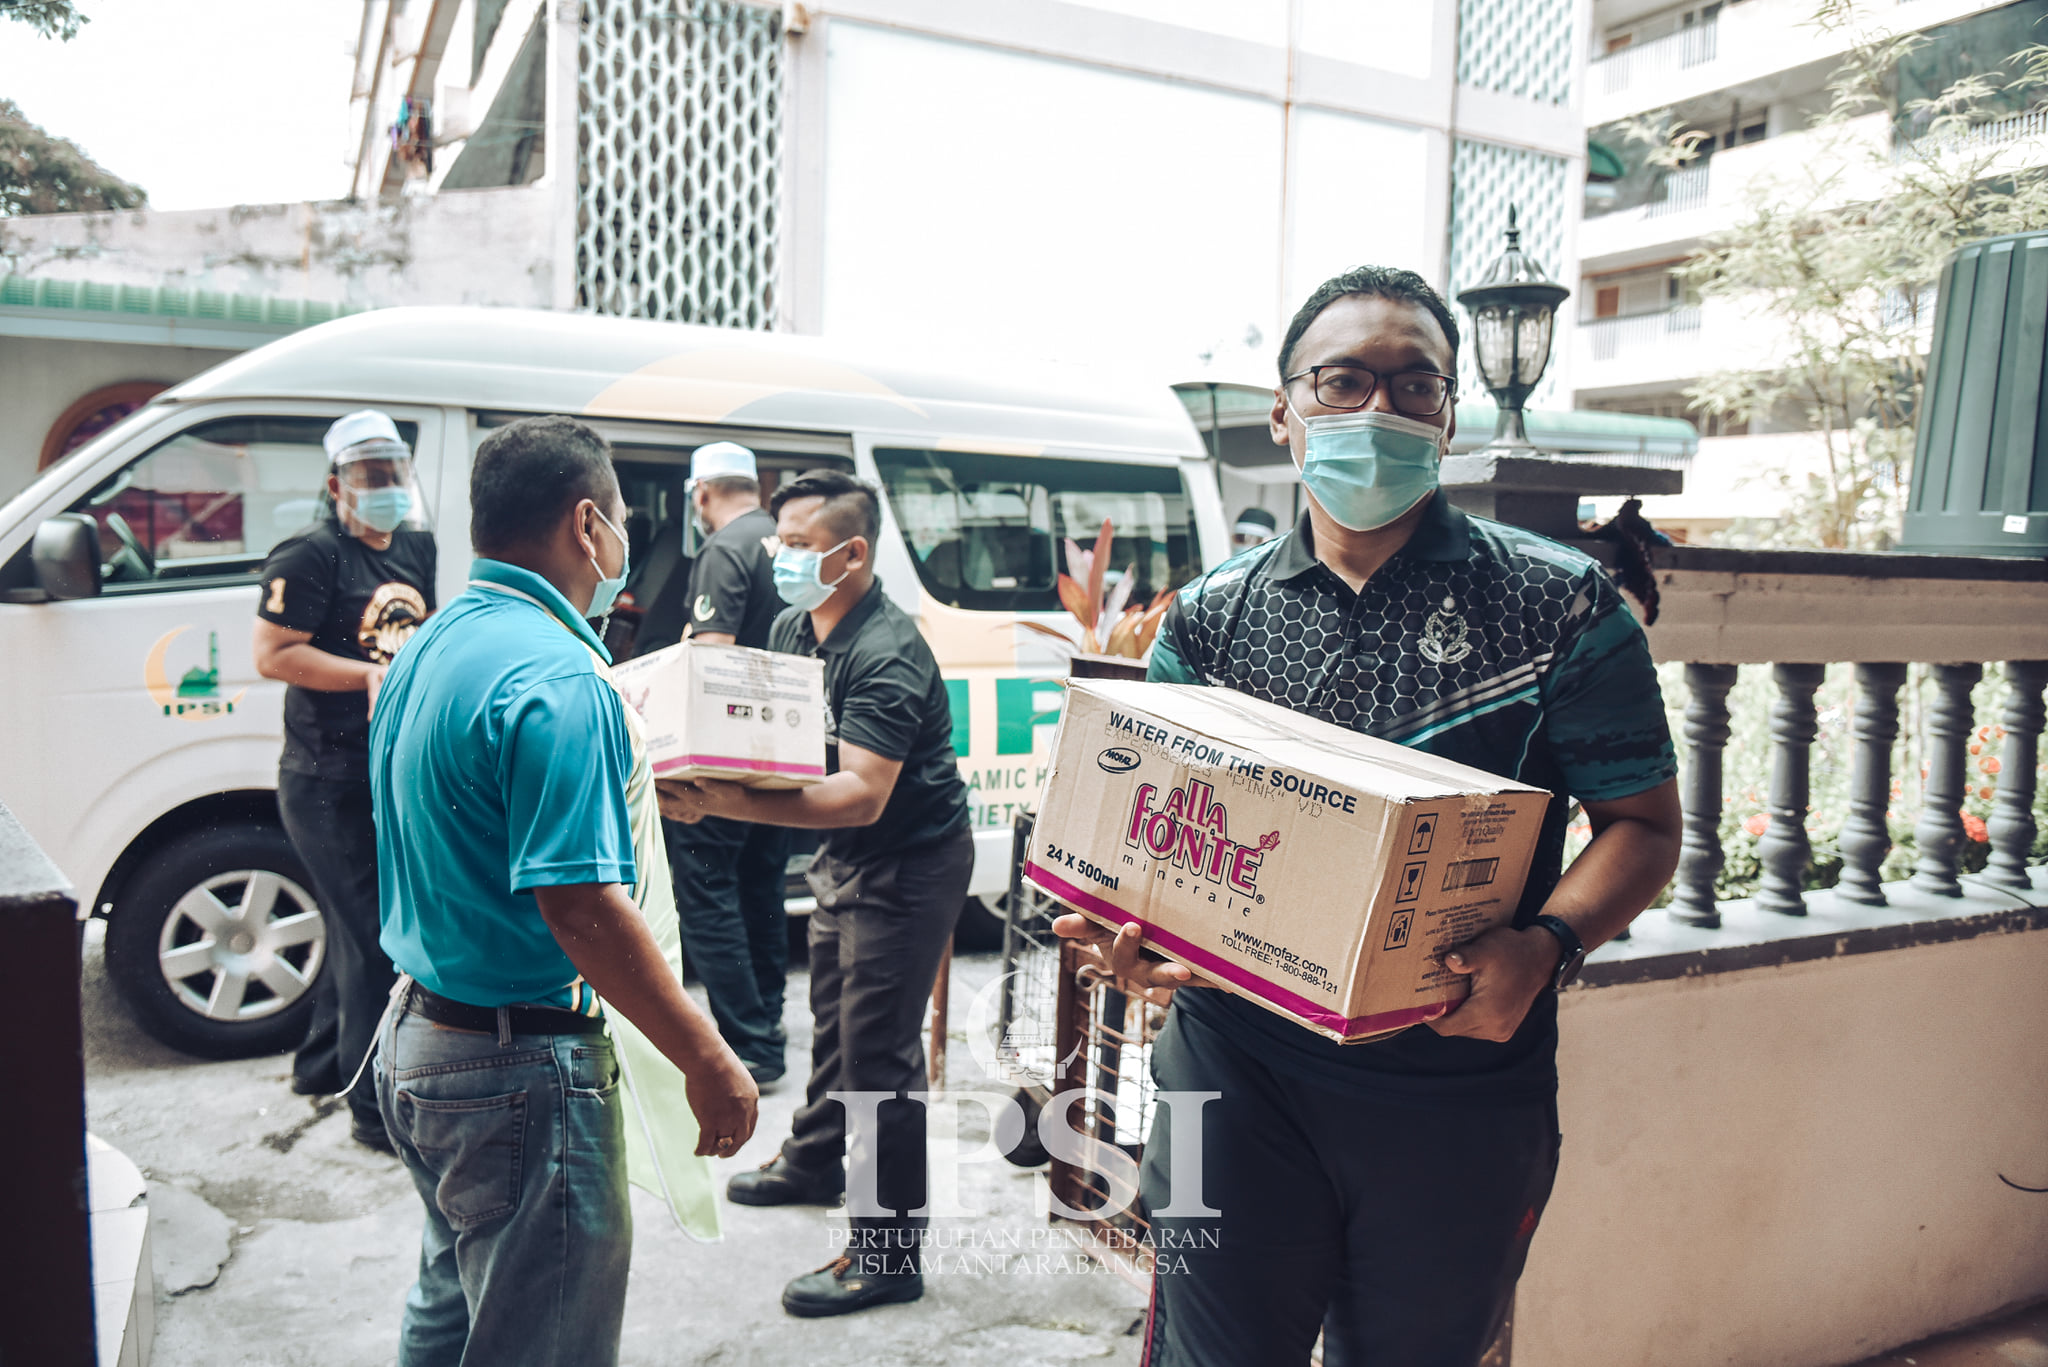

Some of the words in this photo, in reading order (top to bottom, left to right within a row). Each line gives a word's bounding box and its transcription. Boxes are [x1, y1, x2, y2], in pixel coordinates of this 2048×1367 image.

[266, 577, 286, 615] 1
[164, 702, 233, 716] IPSI
[1110, 711, 1168, 745] WATER
[1171, 735, 1224, 766] FROM
[1229, 755, 1265, 781] THE
[1270, 770, 1357, 814] SOURCE
[1047, 844, 1062, 862] 24
[1065, 852, 1075, 869] X
[1077, 859, 1119, 890] 500ml
[1122, 854, 1250, 917] minerale
[1221, 934, 1243, 952] TOLL
[1245, 945, 1273, 965] FREE:
[1275, 960, 1338, 994] 1-800-888-121
[1234, 929, 1328, 978] www.mofaz.com
